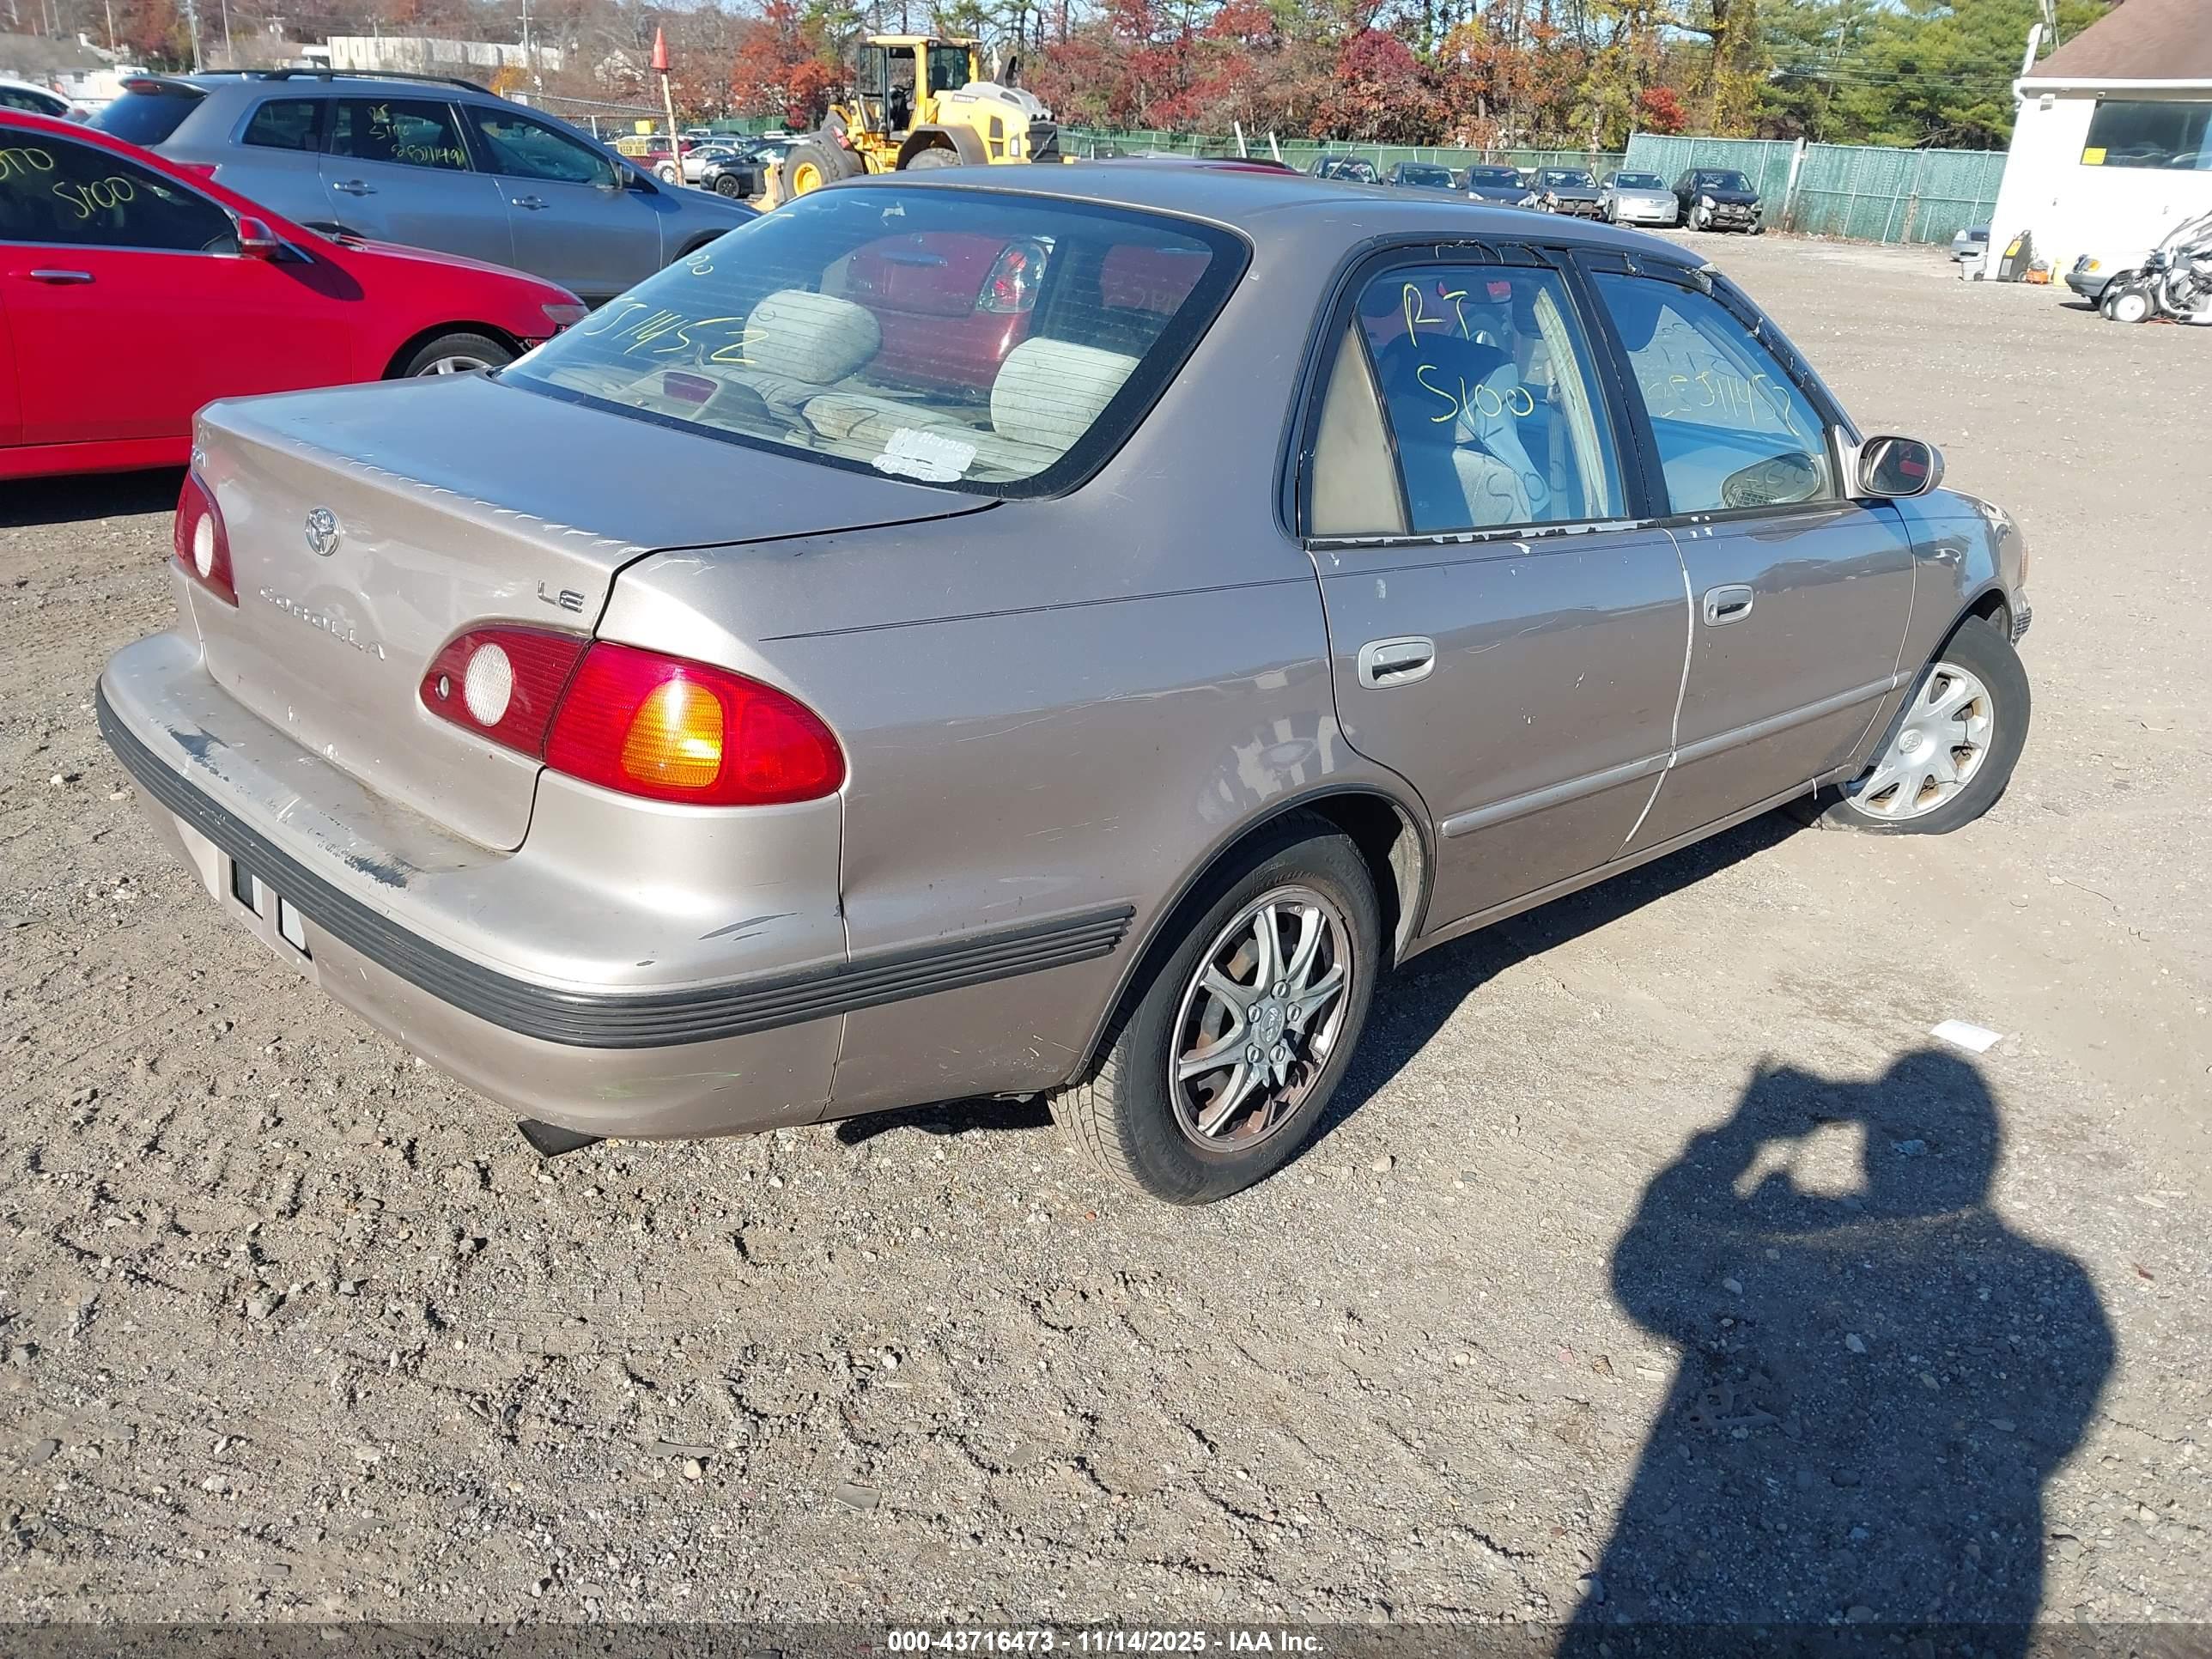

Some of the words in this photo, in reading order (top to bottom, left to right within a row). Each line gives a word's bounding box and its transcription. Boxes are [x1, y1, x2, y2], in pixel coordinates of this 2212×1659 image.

[52, 176, 133, 218] S100
[1416, 364, 1534, 428] S100
[259, 585, 386, 661] COROLLA
[537, 580, 585, 614] LE
